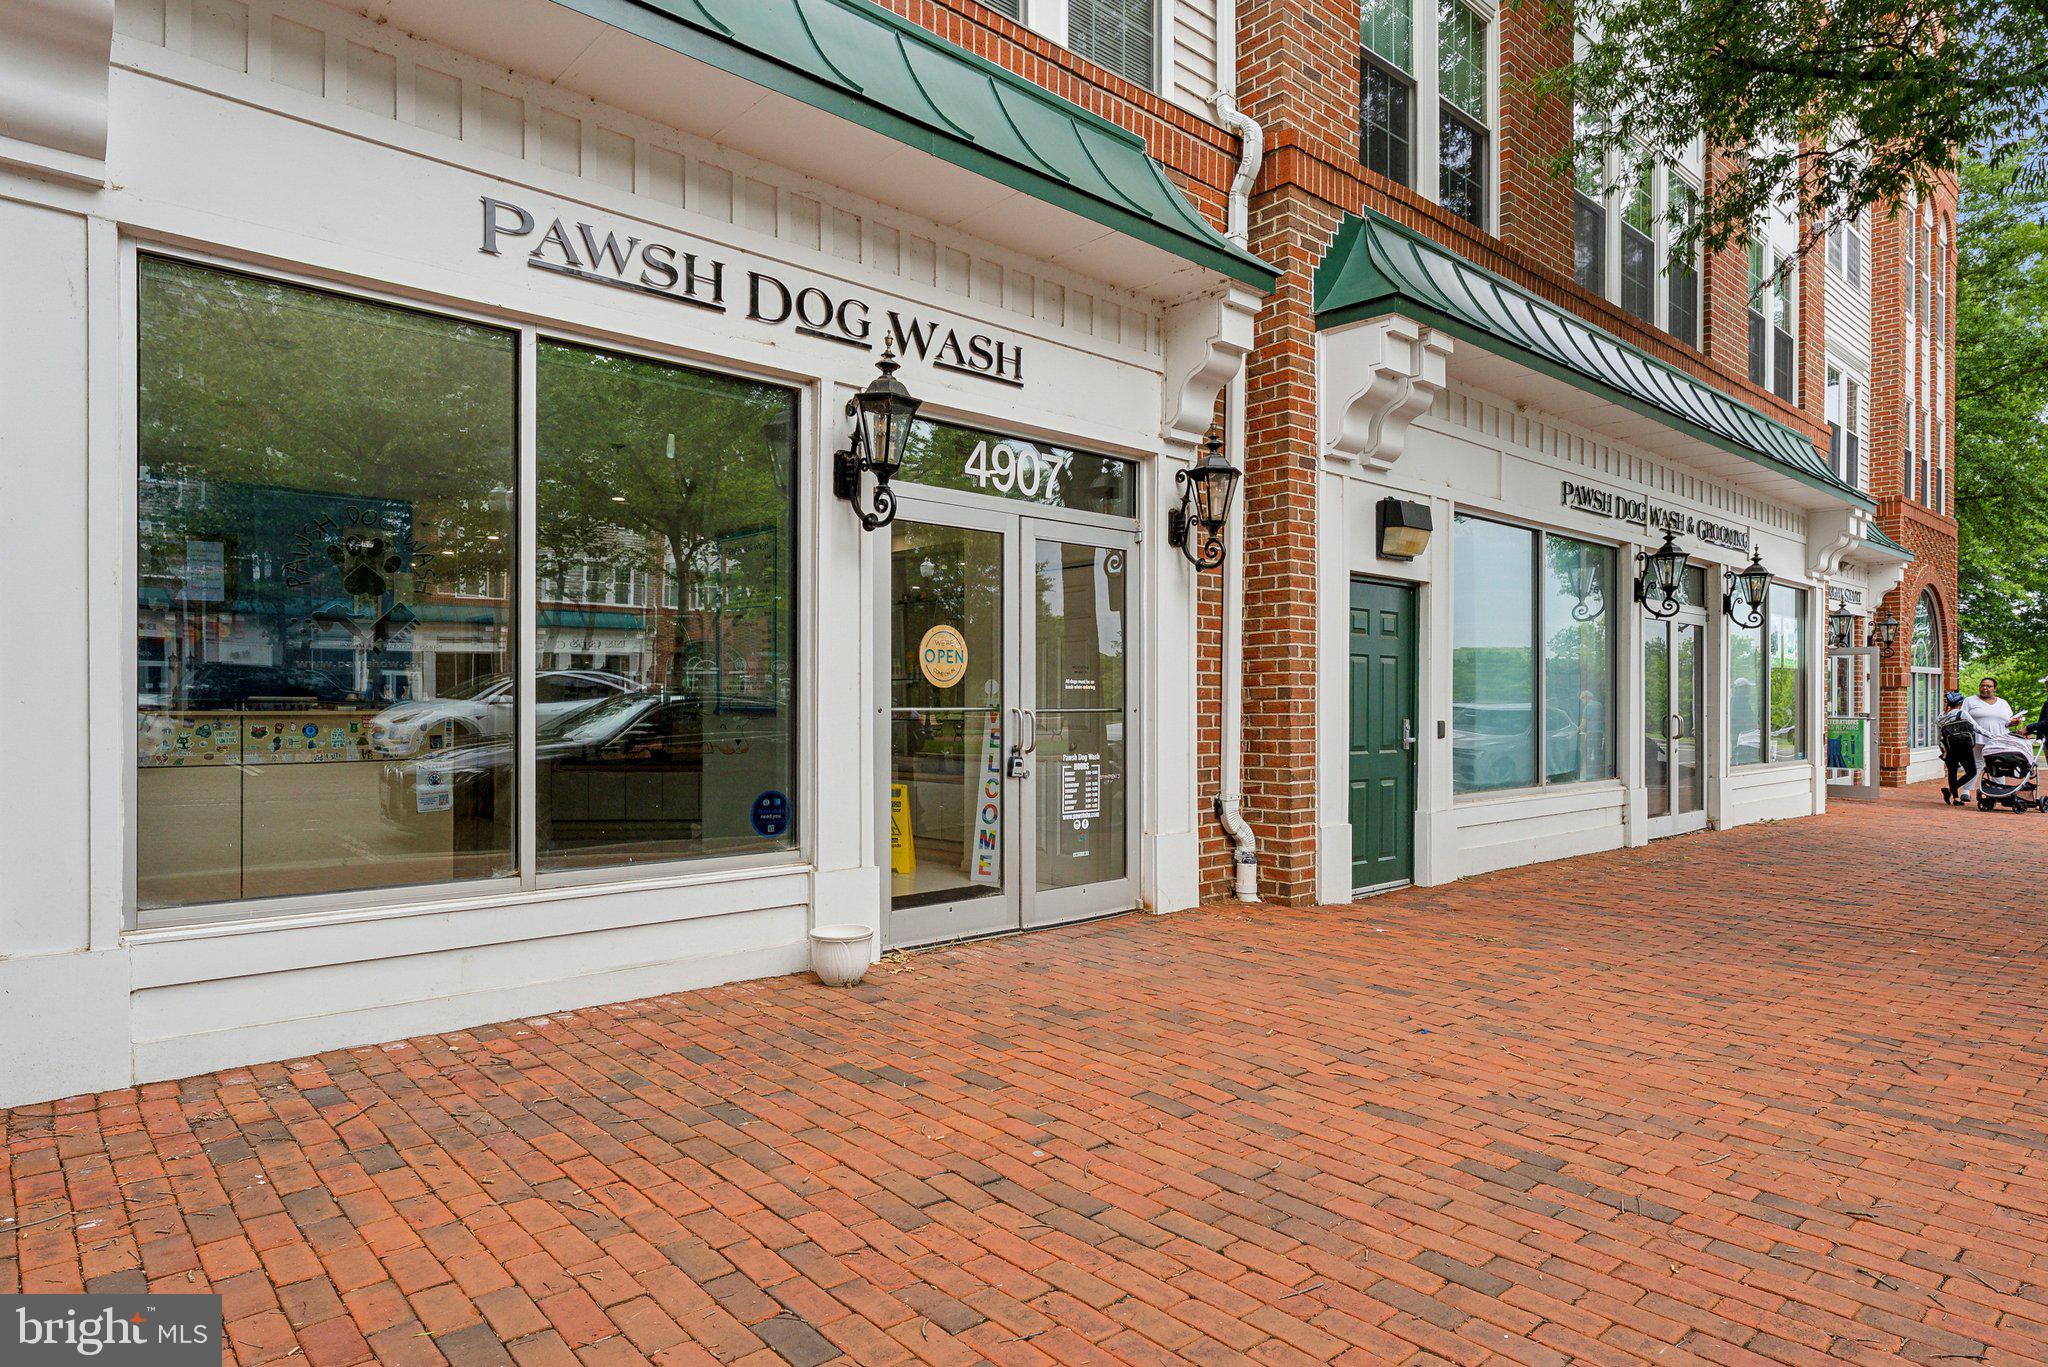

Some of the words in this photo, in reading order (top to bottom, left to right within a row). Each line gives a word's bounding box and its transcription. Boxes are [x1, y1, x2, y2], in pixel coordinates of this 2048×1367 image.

[479, 195, 726, 303] PAWSH
[746, 270, 872, 341] DOG
[886, 310, 1024, 381] WASH
[964, 440, 1063, 499] 4907
[1561, 480, 1612, 513] PAWSH
[1615, 496, 1646, 521] DOG
[1650, 505, 1685, 532] WASH
[1686, 517, 1695, 535] &
[1696, 520, 1750, 549] GROOMING
[283, 512, 338, 588] PAWSH
[403, 533, 437, 596] WASH
[925, 648, 964, 664] OPEN
[978, 703, 1000, 876] WELCOME
[1062, 753, 1077, 761] Pawsh
[1078, 753, 1088, 762] Dog
[1088, 752, 1100, 760] Wash
